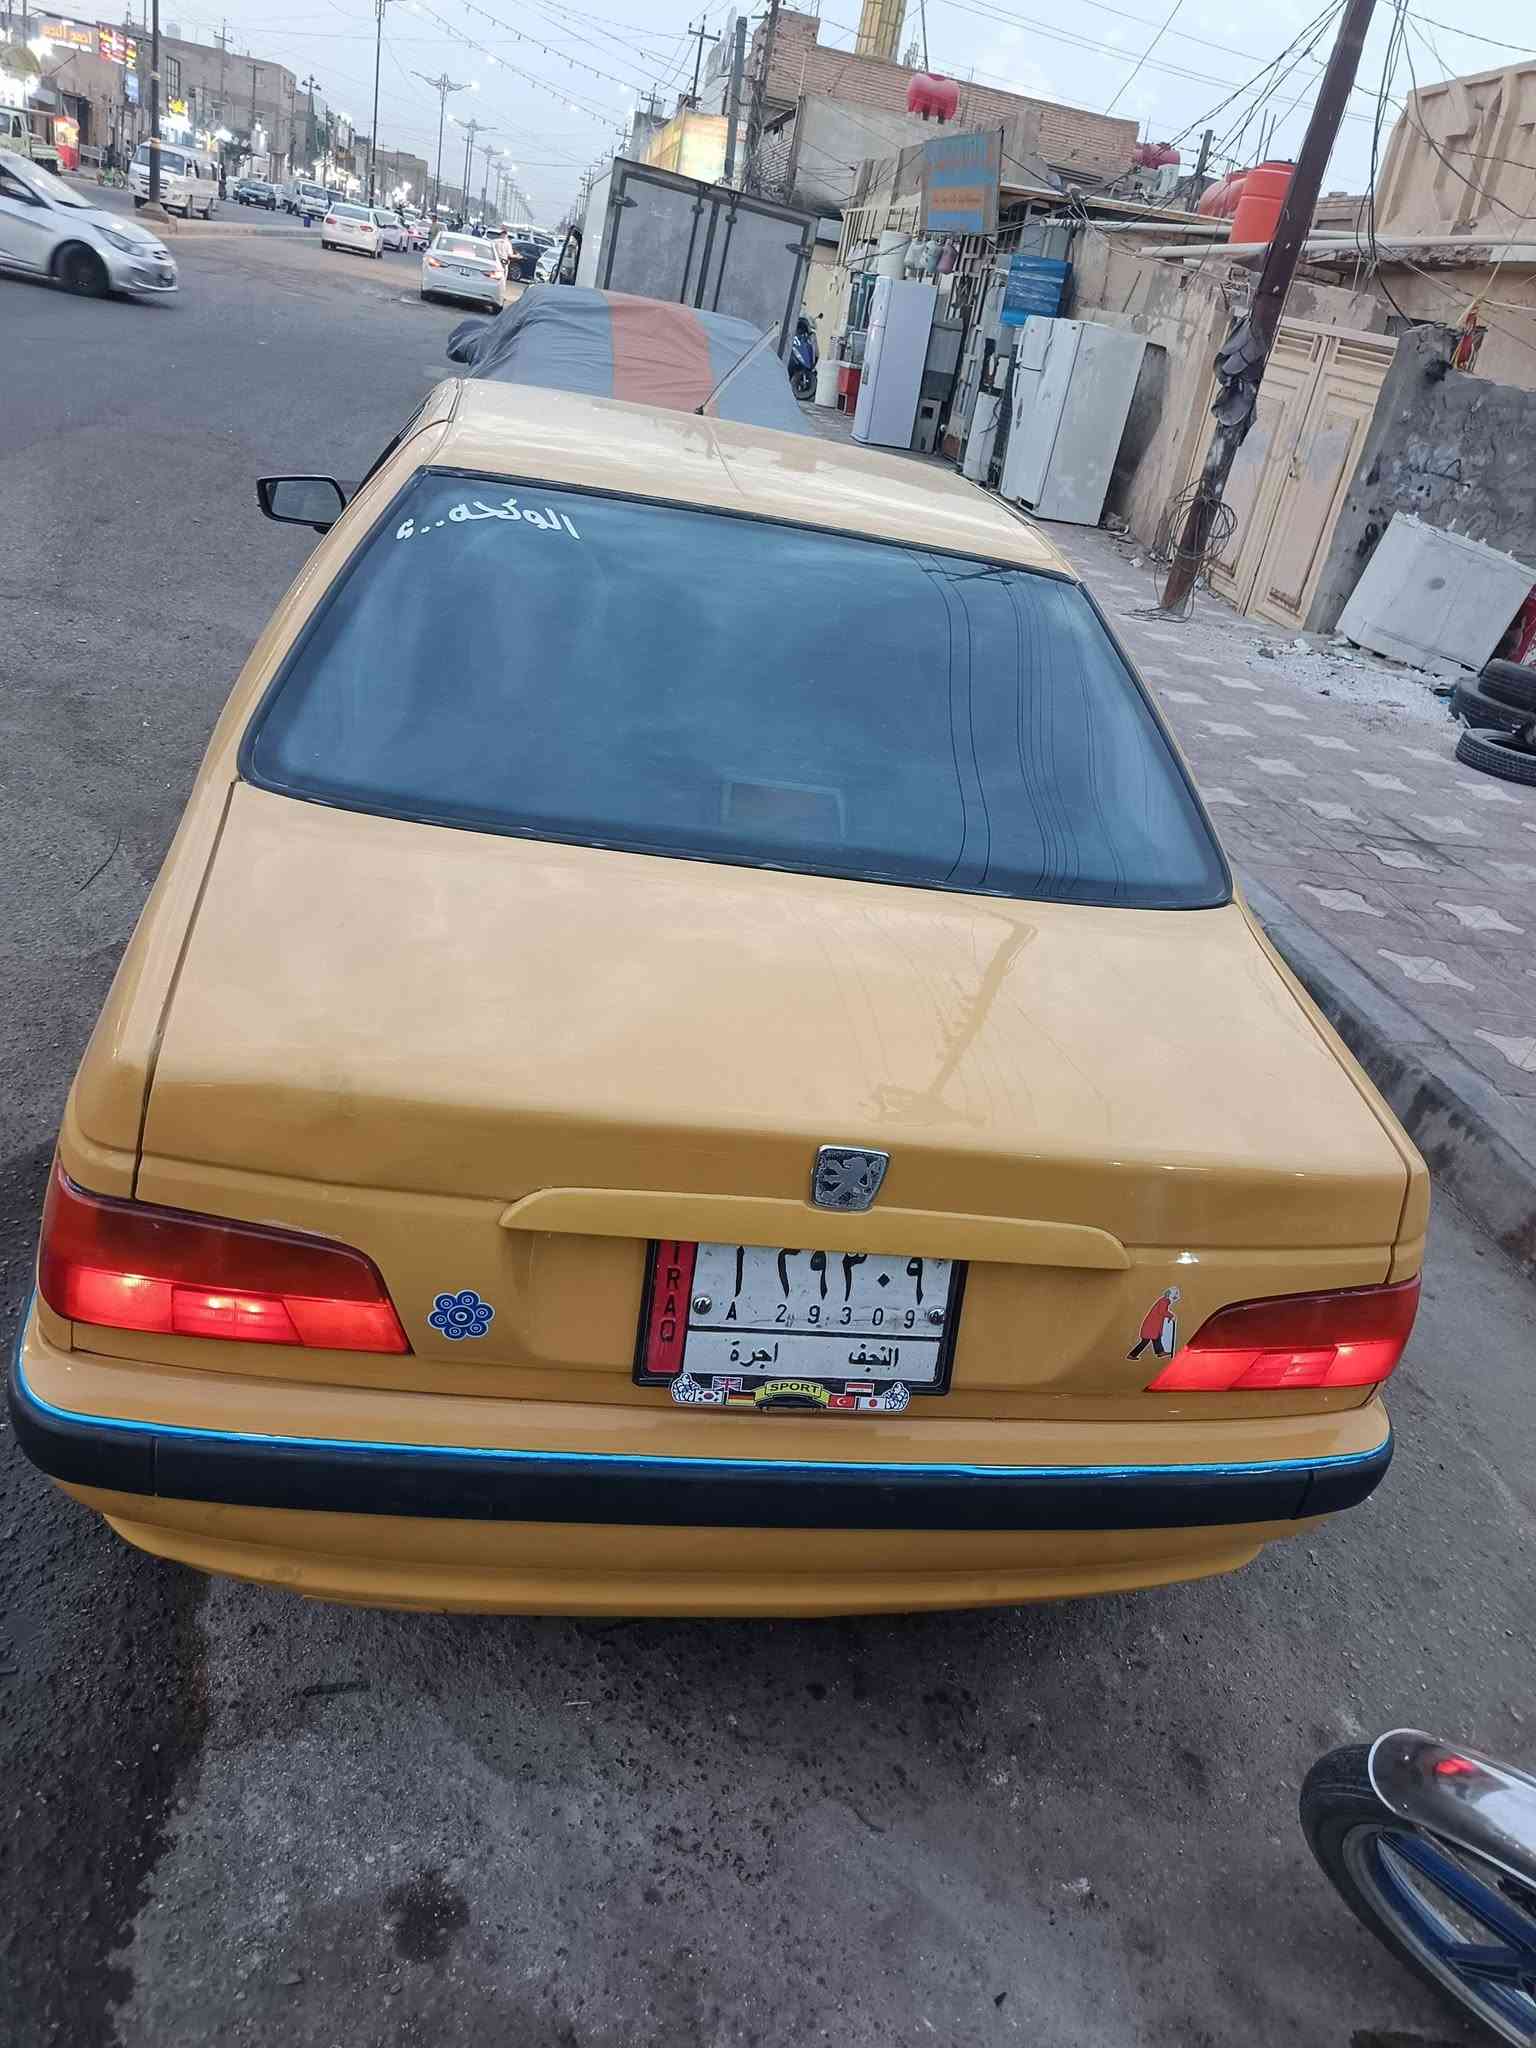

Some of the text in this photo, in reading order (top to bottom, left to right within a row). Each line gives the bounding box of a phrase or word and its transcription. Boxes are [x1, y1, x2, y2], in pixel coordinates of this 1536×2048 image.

[730, 1340, 900, 1373] النجف اجرة
[769, 1380, 822, 1394] SPORT
